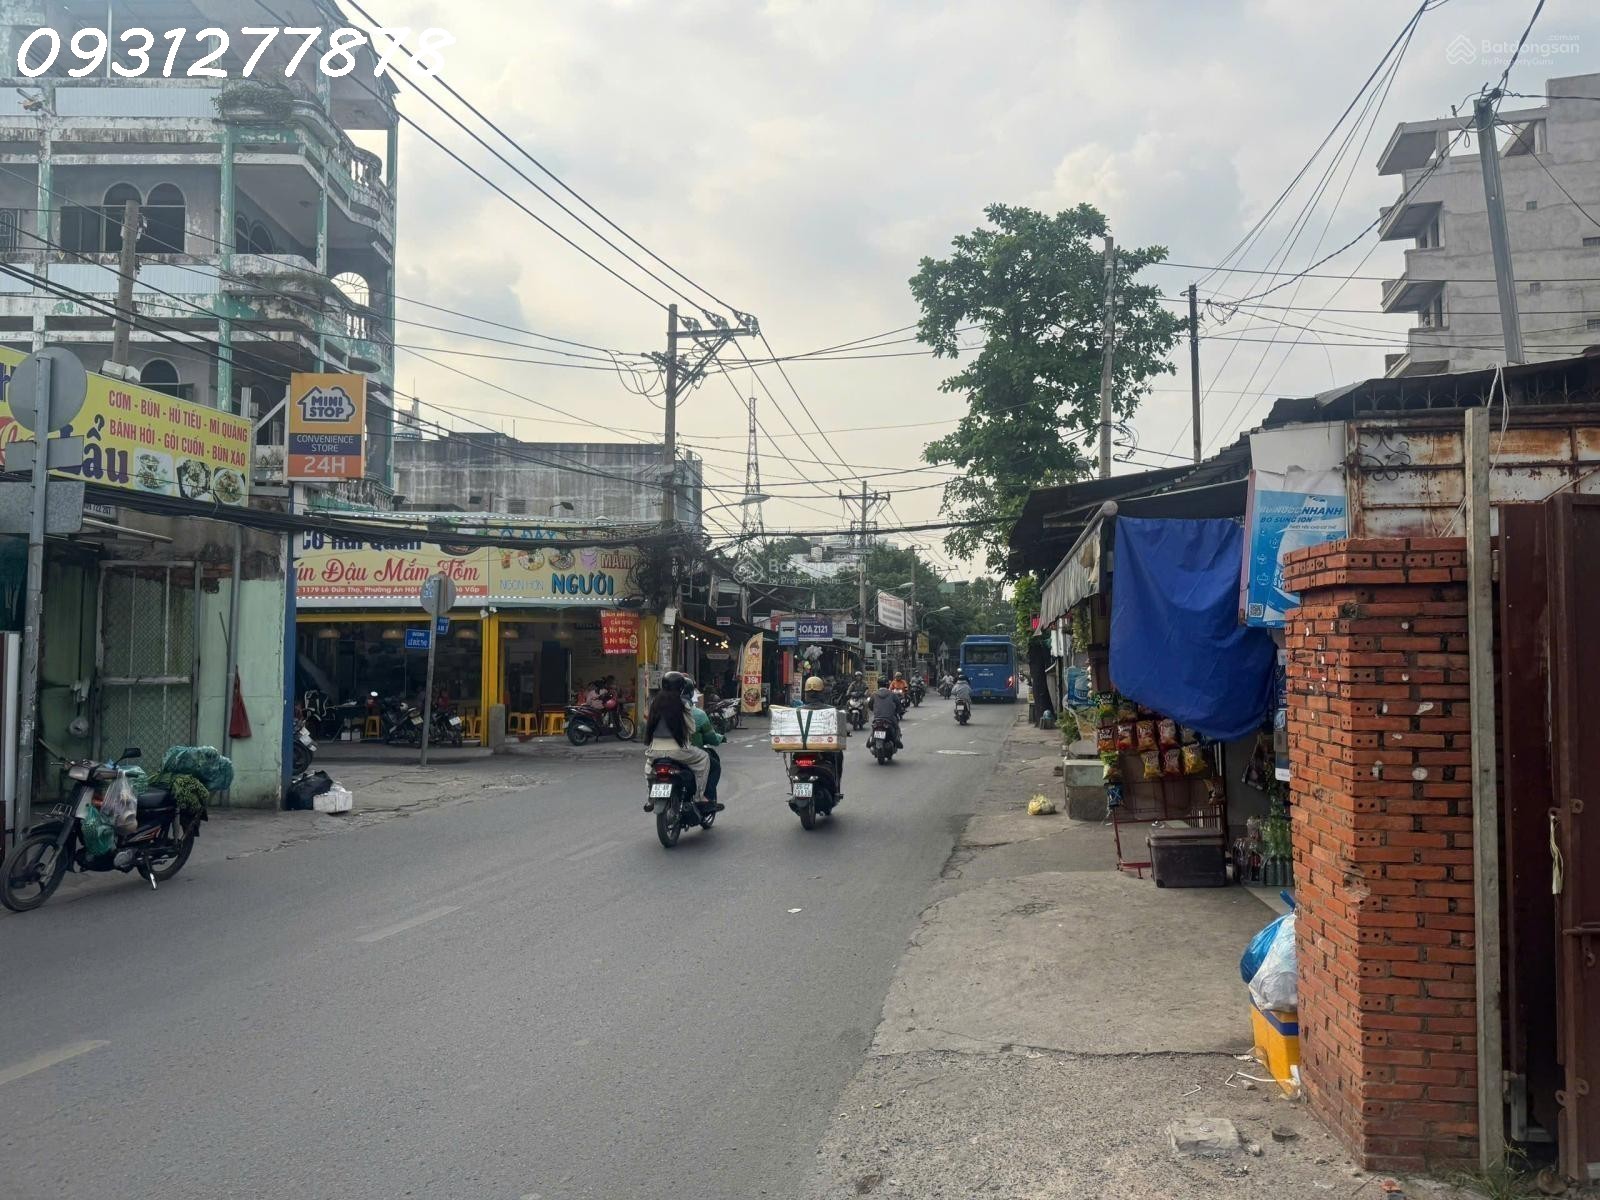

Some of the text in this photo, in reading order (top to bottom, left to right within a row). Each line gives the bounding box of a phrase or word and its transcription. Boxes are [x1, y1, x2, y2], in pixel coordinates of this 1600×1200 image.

[109, 390, 131, 411] CƠM
[141, 398, 160, 418] BÚN
[311, 396, 343, 406] MINI
[309, 407, 345, 418] STOP
[109, 418, 137, 441] BÁNH
[212, 444, 228, 462] BÚN
[296, 434, 354, 444] CONVENIENCE
[311, 444, 339, 452] STORE
[304, 456, 345, 474] 24H
[1302, 506, 1343, 515] NHANH
[321, 558, 368, 586] Đậu
[374, 558, 429, 581] Mắm
[551, 571, 614, 596] NGƯỜI
